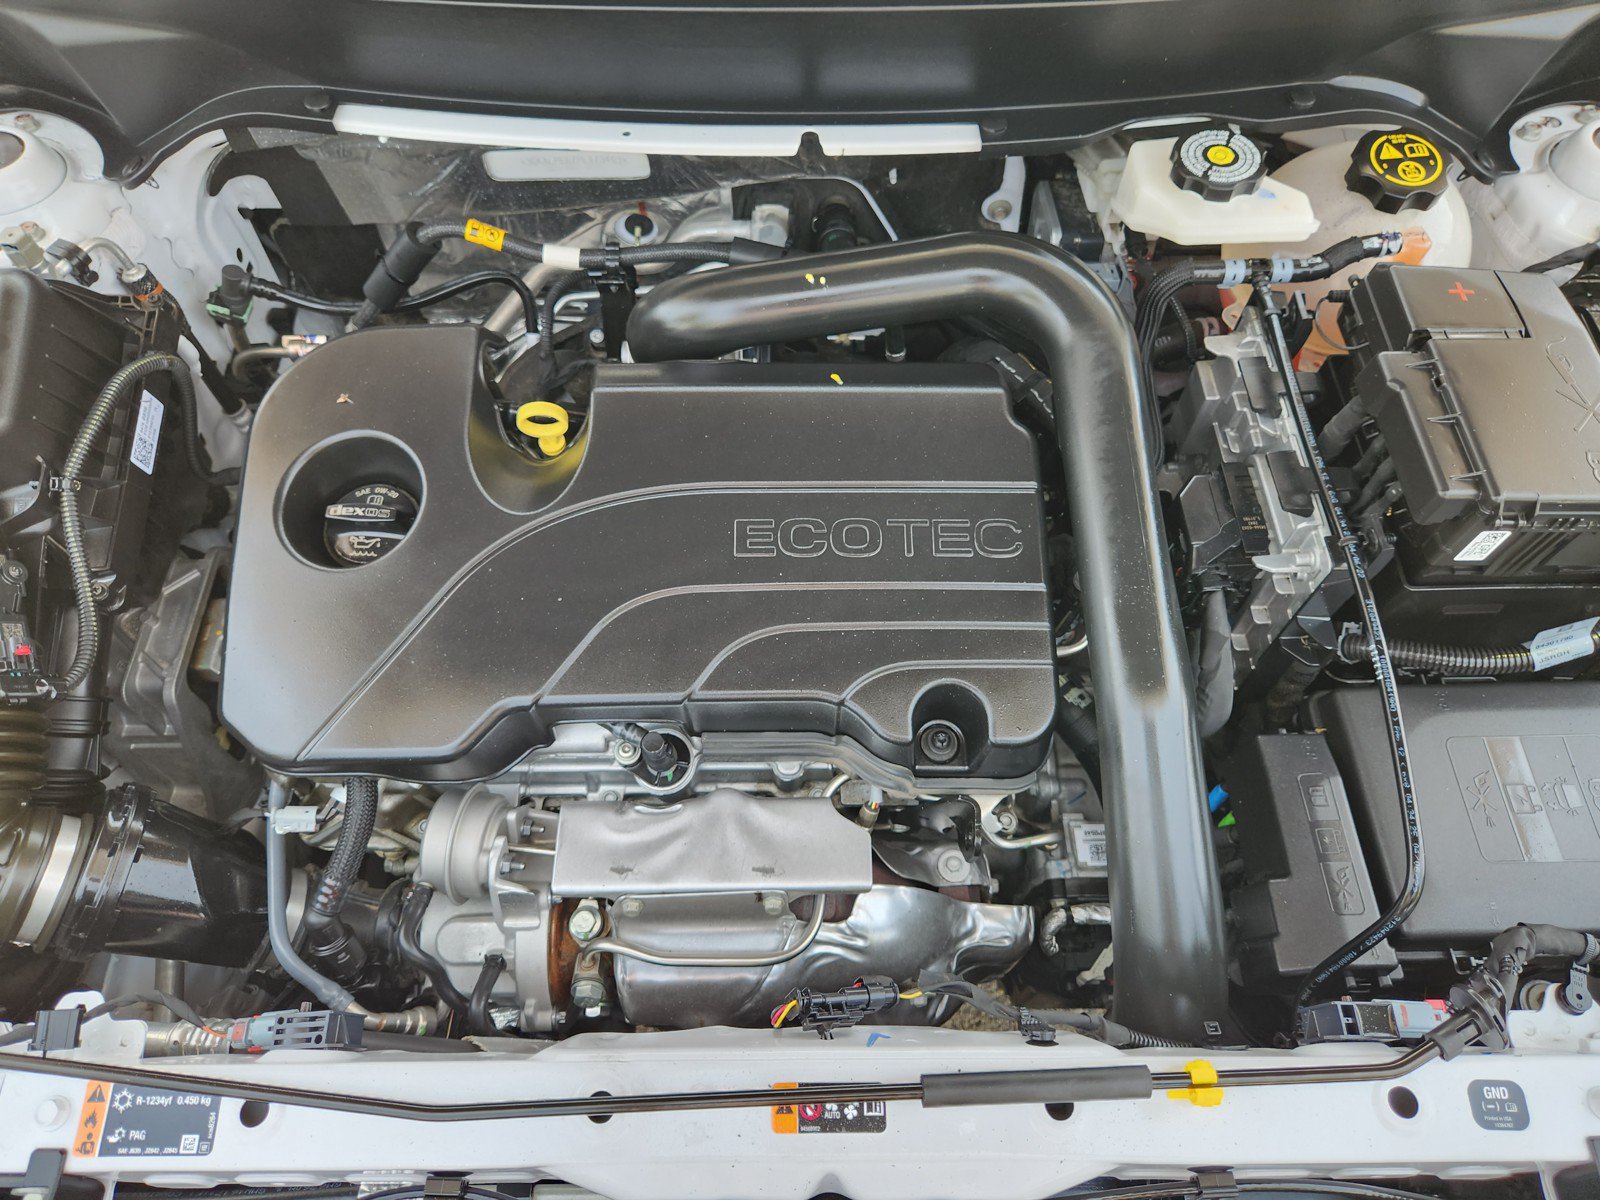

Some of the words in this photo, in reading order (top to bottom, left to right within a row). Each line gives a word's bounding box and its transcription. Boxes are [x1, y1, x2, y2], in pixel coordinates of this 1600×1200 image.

[355, 487, 372, 498] SAE
[374, 486, 400, 499] 0W-20
[329, 504, 391, 518] dexos
[733, 517, 1023, 559] ECOTEC
[1483, 1086, 1509, 1100] GND
[135, 1095, 173, 1107] R-1234yf
[177, 1096, 199, 1106] 0.450
[200, 1096, 212, 1107] kg
[824, 1111, 841, 1120] AUTO
[128, 1129, 147, 1141] PAG
